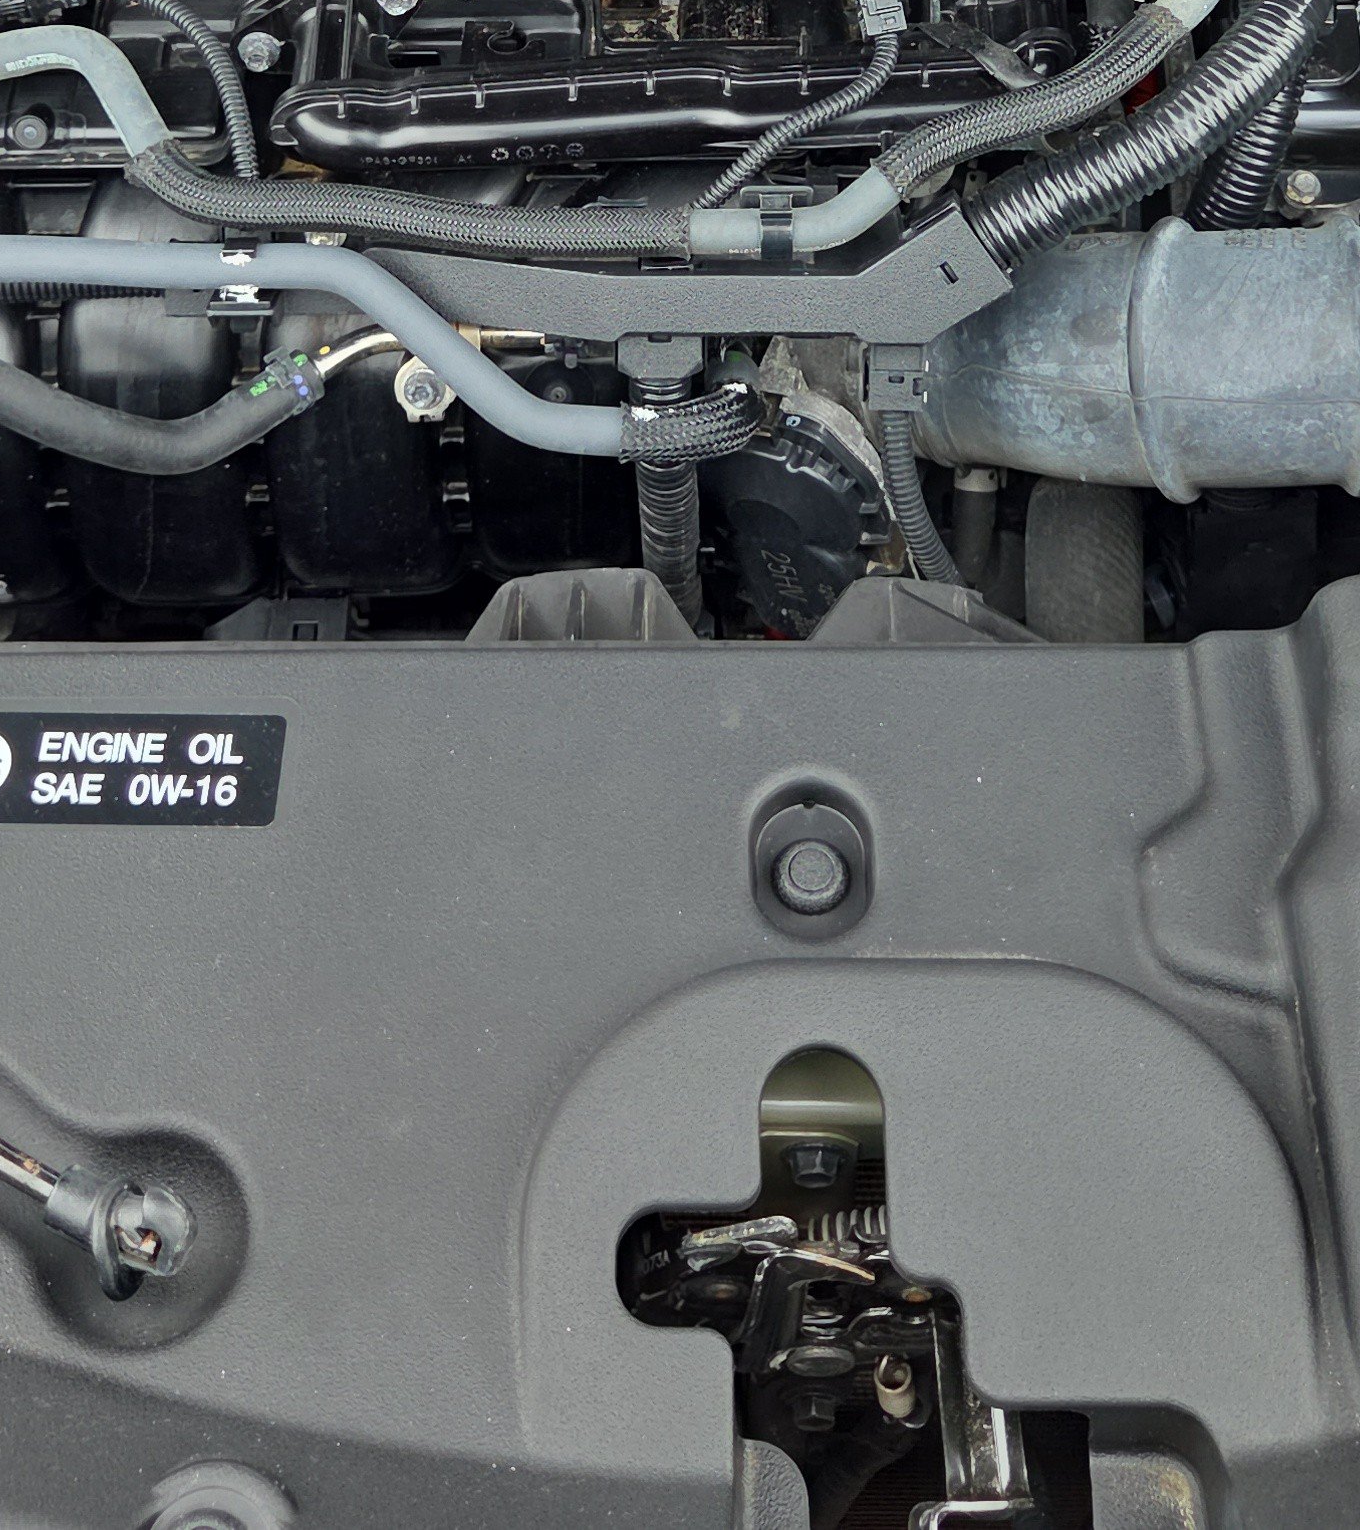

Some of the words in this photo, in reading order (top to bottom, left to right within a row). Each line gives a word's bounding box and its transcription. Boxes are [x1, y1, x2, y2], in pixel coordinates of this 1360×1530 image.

[36, 731, 168, 764] ENGINE
[187, 732, 244, 765] OIL
[31, 773, 103, 805] SAE
[128, 775, 239, 807] 0W-16
